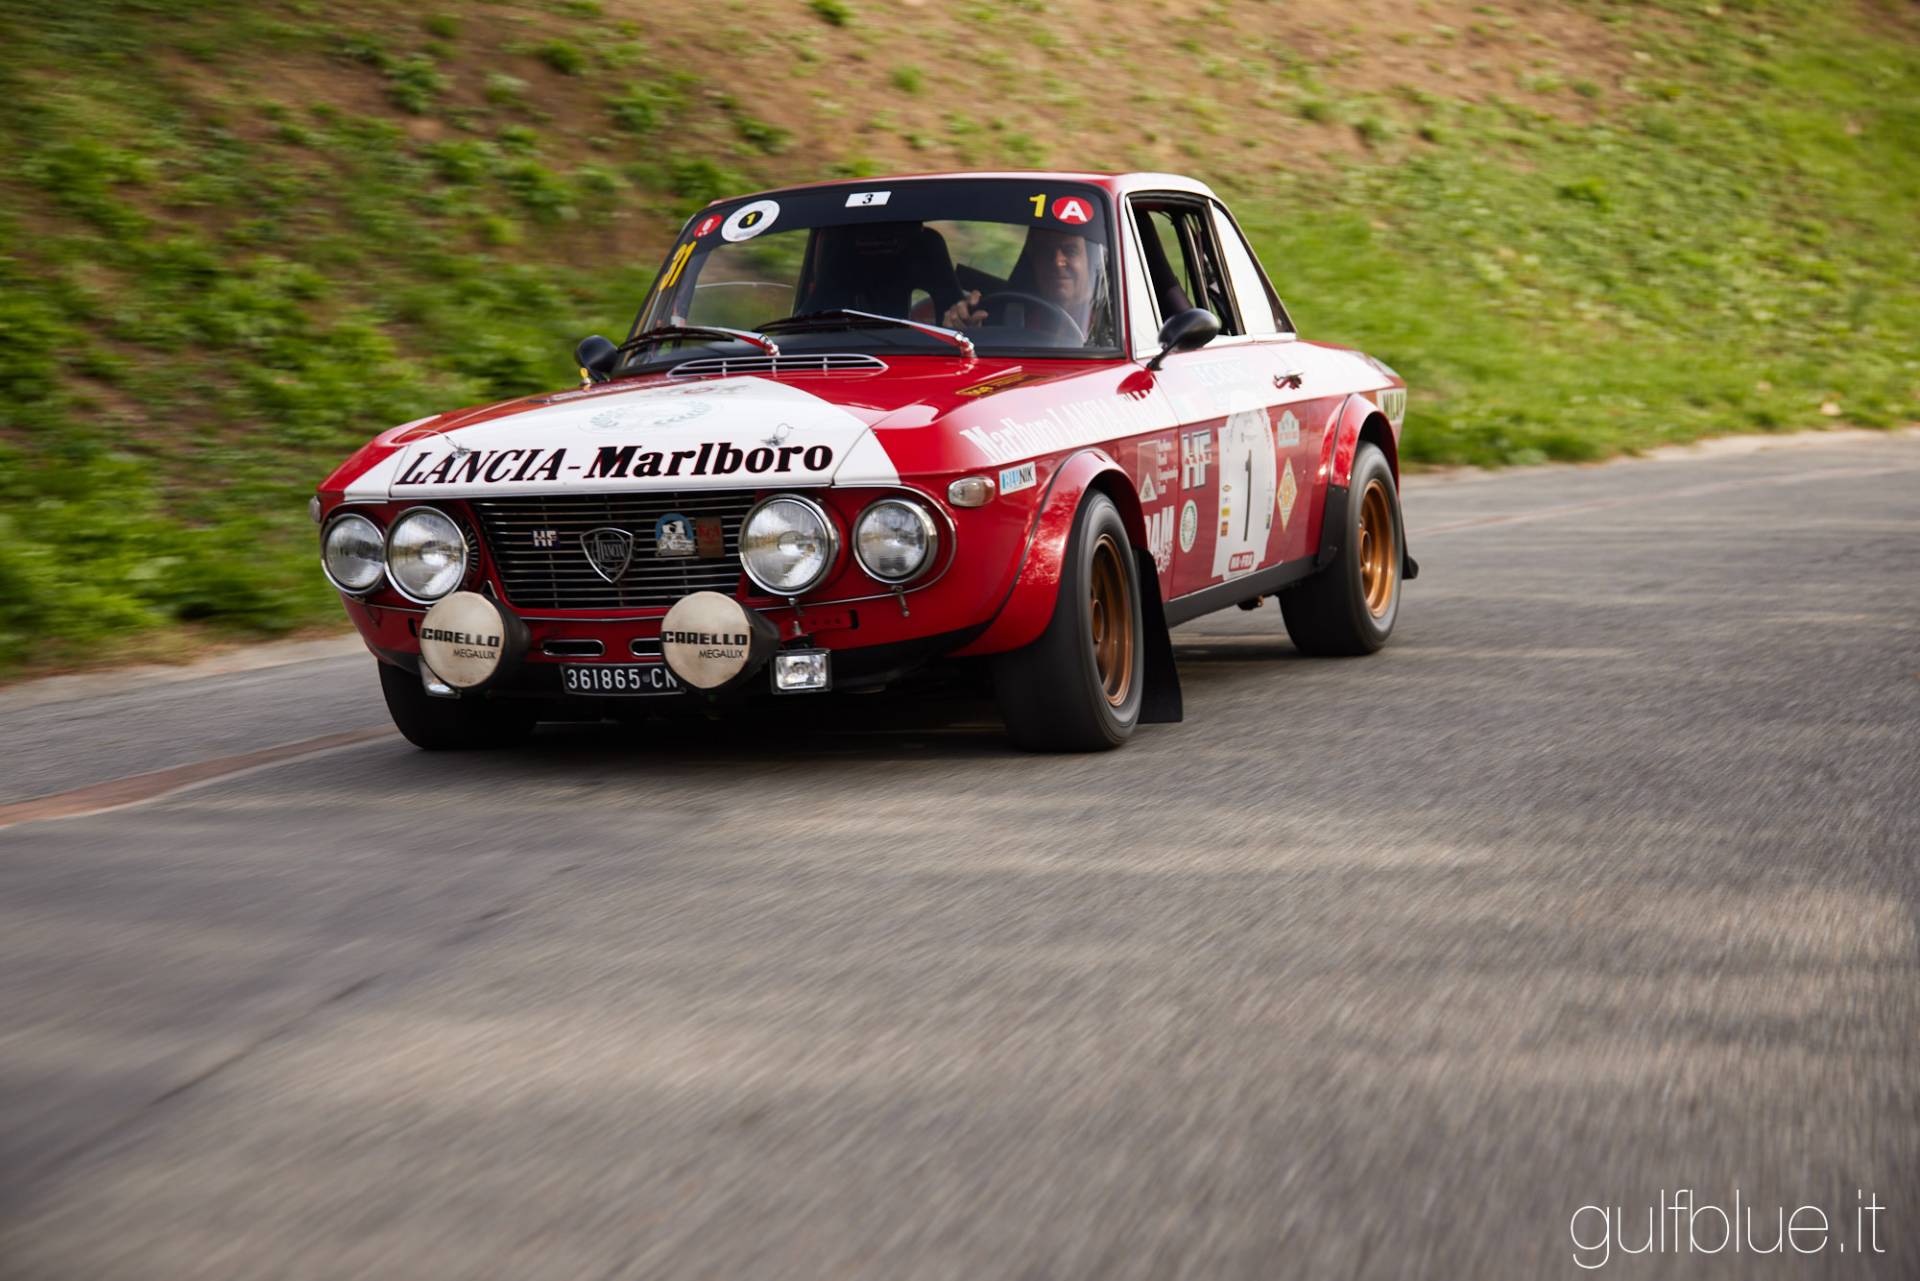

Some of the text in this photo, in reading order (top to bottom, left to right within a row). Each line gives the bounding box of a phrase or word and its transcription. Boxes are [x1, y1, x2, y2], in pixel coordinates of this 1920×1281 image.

[861, 193, 875, 205] 3
[1029, 193, 1047, 218] 1
[746, 213, 757, 226] 1
[1059, 200, 1088, 222] A
[1181, 429, 1212, 490] HF
[1243, 449, 1253, 542] 1
[533, 529, 557, 547] HF
[421, 627, 500, 648] CARELLO
[661, 630, 748, 646] CARELLO
[452, 648, 497, 660] MEGALUX
[698, 648, 744, 659] MEGALUX
[567, 668, 641, 690] 361865
